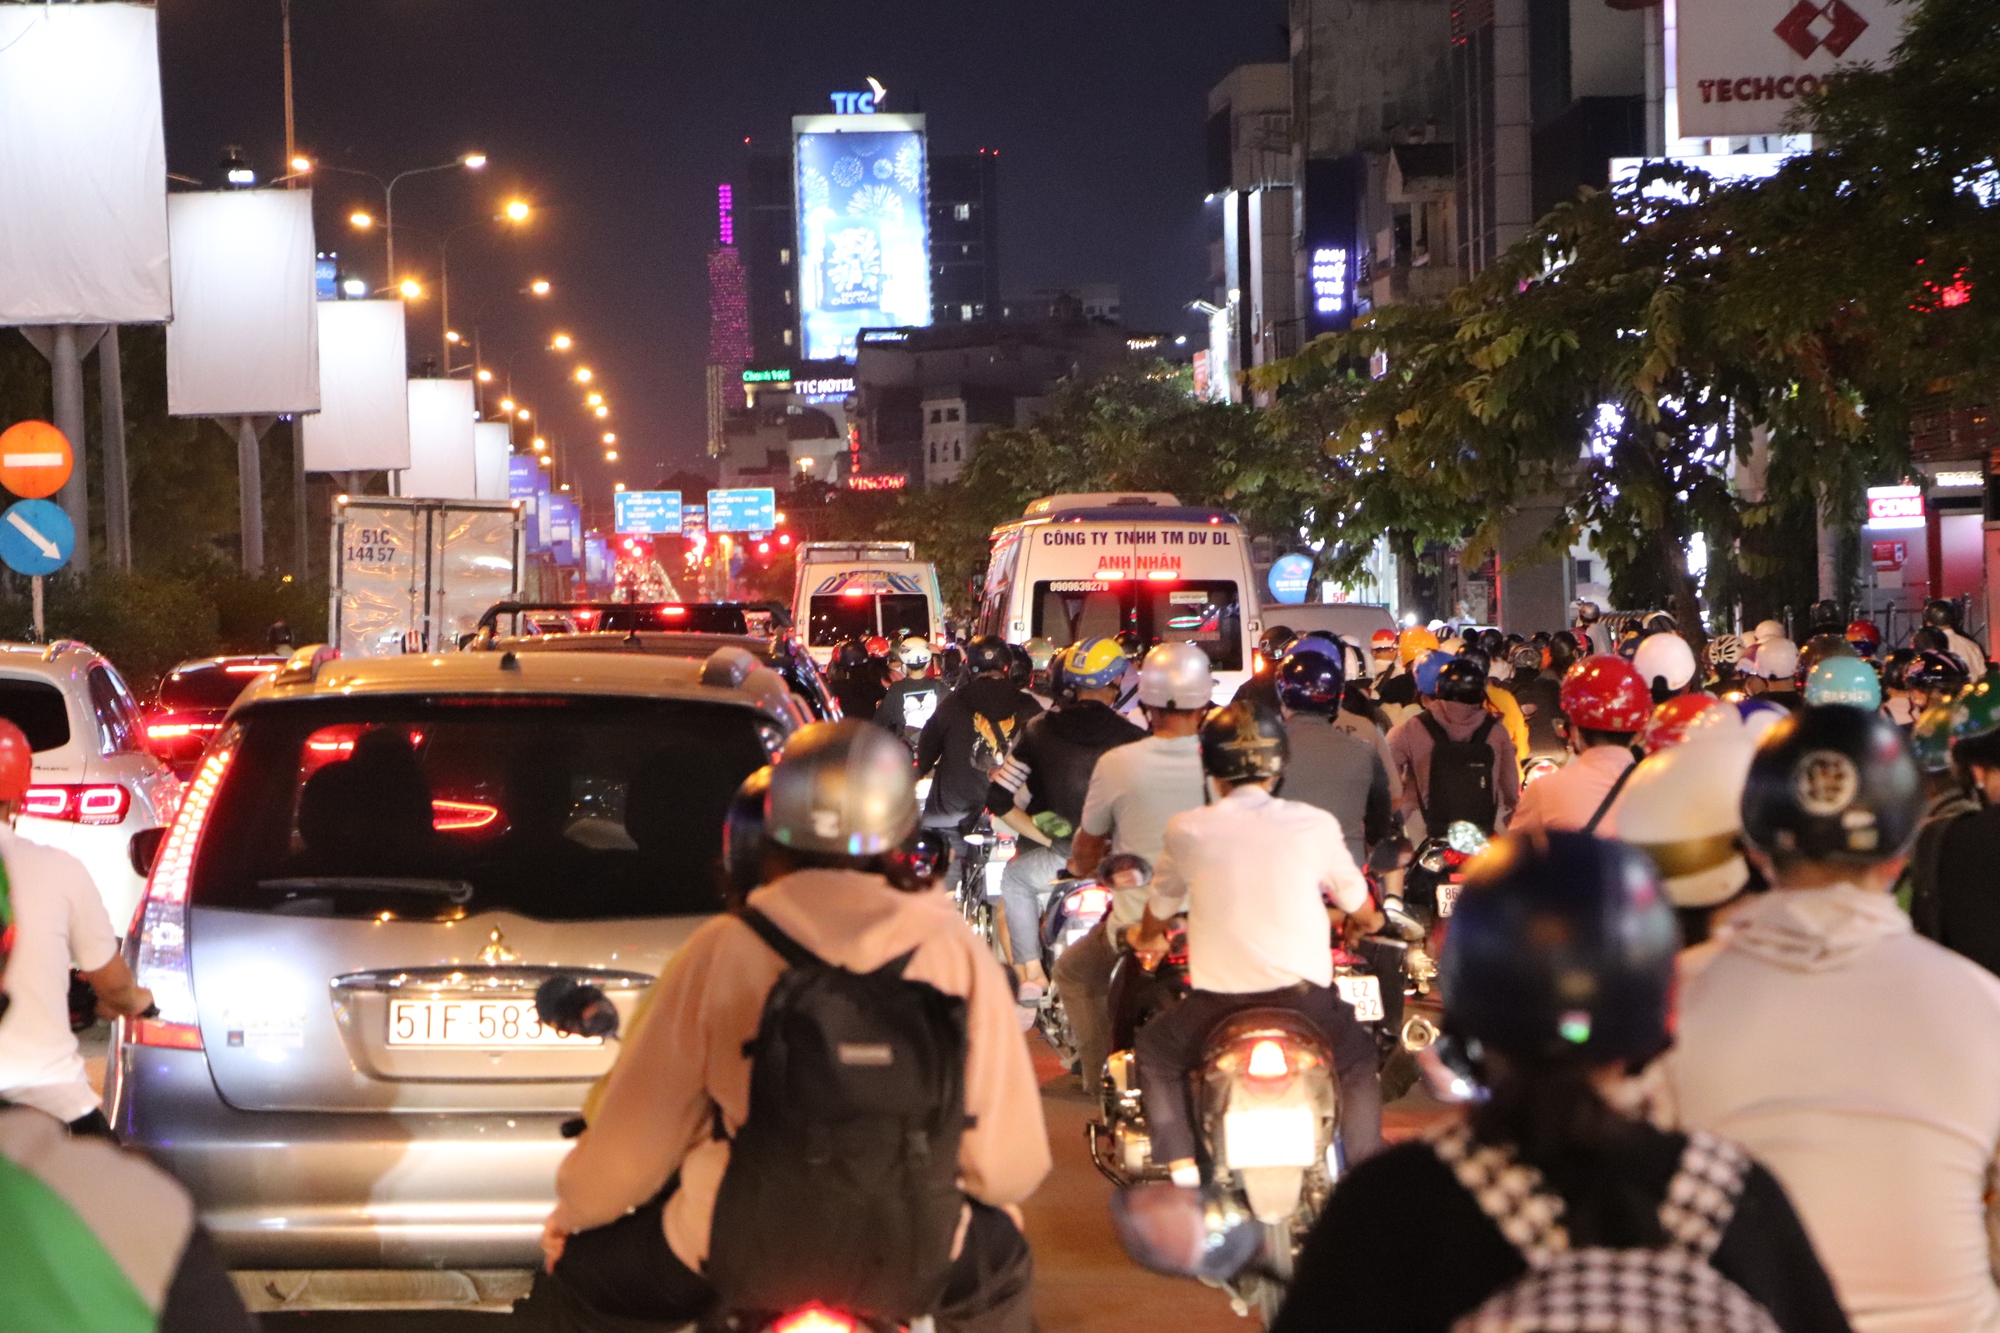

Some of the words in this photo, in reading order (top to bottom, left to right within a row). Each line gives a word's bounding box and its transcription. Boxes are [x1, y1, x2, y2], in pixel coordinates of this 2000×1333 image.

[830, 91, 875, 115] TTC
[818, 378, 856, 393] HOTEL
[848, 476, 906, 490] VINCOM
[1871, 497, 1922, 517] CDM
[362, 529, 390, 545] 51C
[1043, 530, 1086, 546] CÔNG
[1091, 531, 1109, 546] TY
[1115, 531, 1156, 545] TNHH
[1161, 531, 1184, 545] TM
[1188, 531, 1208, 545] DV
[1213, 531, 1231, 546] DL
[1098, 556, 1131, 569] ANH
[1137, 553, 1182, 569] NHÂN
